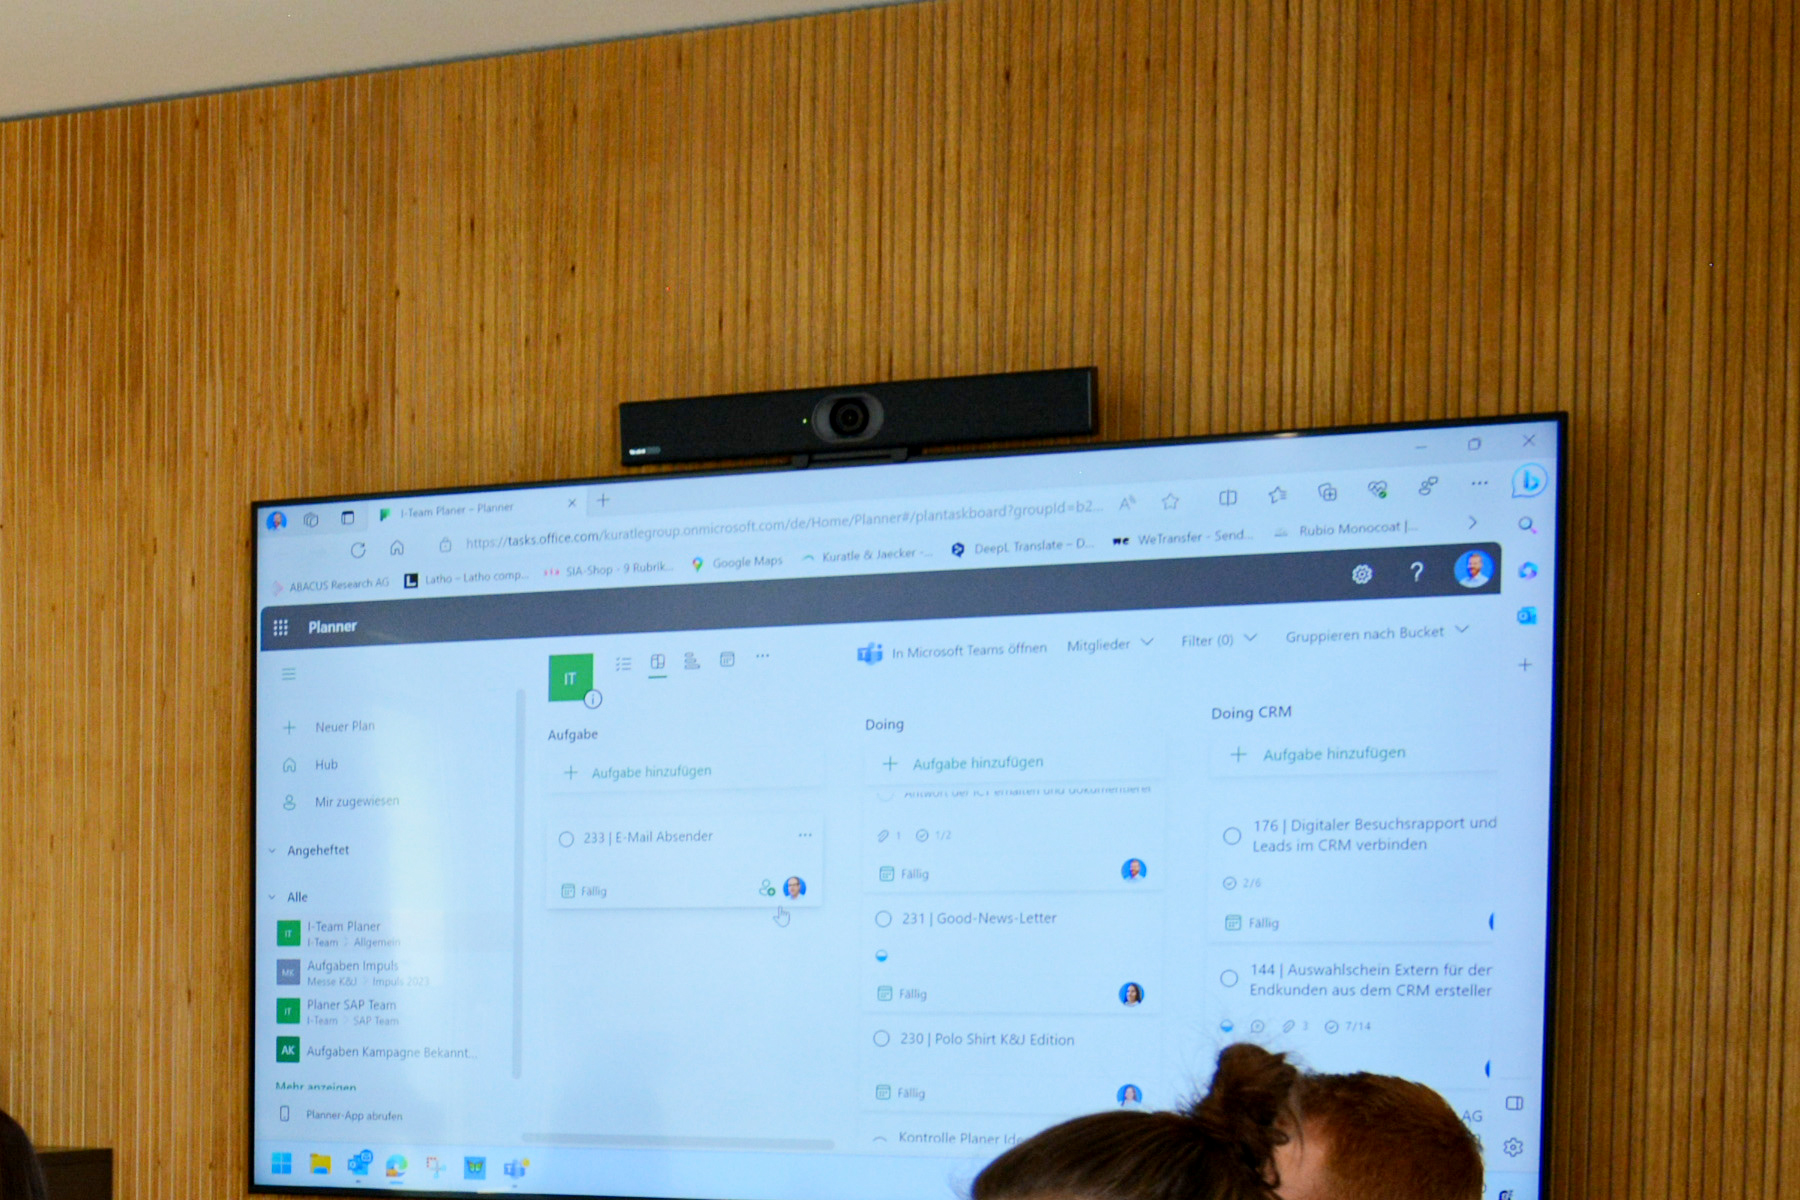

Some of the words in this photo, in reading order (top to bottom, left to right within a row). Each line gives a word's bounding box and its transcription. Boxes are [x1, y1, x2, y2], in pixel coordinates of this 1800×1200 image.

[436, 505, 466, 517] Planer
[477, 502, 514, 514] Planner
[1299, 524, 1334, 537] Rubio
[1338, 521, 1400, 535] Monocoat
[1138, 531, 1202, 546] WeTransfer
[975, 542, 1009, 556] DeepL
[1014, 539, 1063, 552] Translate
[713, 556, 751, 570] Google
[754, 555, 783, 568] Maps
[823, 550, 860, 563] Kuratle
[864, 550, 873, 560] &
[876, 548, 915, 560] Jaecker
[566, 564, 613, 577] SIA-Shop
[623, 563, 630, 573] 9
[290, 580, 329, 592] ABACUS
[331, 578, 373, 590] Research
[374, 576, 390, 587] AG
[425, 573, 452, 585] Latho
[463, 571, 491, 583] Latho
[308, 620, 358, 635] Planner
[1182, 634, 1213, 647] Filter
[1217, 633, 1234, 648] (0)
[1286, 630, 1359, 645] Gruppieren
[1363, 627, 1395, 641] nach
[1399, 625, 1444, 639] Bucket
[892, 647, 903, 659] In
[907, 645, 963, 659] Microsoft
[967, 643, 1004, 656] Teams
[1008, 641, 1047, 655] öffnen
[1067, 637, 1130, 654] Mitglieder
[564, 672, 577, 686] IT
[1211, 707, 1254, 721] Doing
[1258, 706, 1293, 719] CRM
[315, 720, 348, 733] Neuer
[352, 720, 375, 732] Plan
[865, 719, 905, 733] Doing
[547, 728, 599, 744] Aufgabe
[1263, 748, 1323, 764] Aufgabe
[1326, 746, 1406, 762] hinzufügen
[315, 759, 338, 770] Hub
[913, 757, 967, 773] Aufgabe
[971, 755, 1044, 771] hinzufügen
[591, 767, 641, 781] Aufgabe
[645, 764, 712, 780] hinzufügen
[315, 796, 333, 808] Mir
[336, 794, 400, 810] zugewiesen
[1254, 820, 1278, 833] 176
[1291, 818, 1350, 834] Digitaler
[1354, 817, 1465, 833] Besuchsrapport
[1470, 816, 1497, 830] und
[583, 832, 605, 844] 233
[615, 830, 653, 844] E-Mail
[656, 830, 714, 843] Absender
[1253, 839, 1292, 853] Leads
[1296, 838, 1314, 852] im
[1318, 838, 1351, 852] CRM
[1356, 837, 1428, 852] verbinden
[287, 844, 349, 862] Angeheftet
[901, 868, 929, 882] Fällig
[287, 891, 308, 903] Alle
[581, 886, 607, 898] Fällig
[902, 913, 925, 925] 231
[936, 912, 1057, 925] Good-News-Letter
[1249, 917, 1279, 932] Fällig
[307, 921, 344, 932] I-Team
[347, 921, 381, 932] Planer
[307, 937, 339, 947] I-Team
[354, 937, 401, 949] Allgemein
[307, 960, 360, 973] Aufgaben
[363, 960, 399, 973] Impuls
[1251, 963, 1275, 976] 144
[1287, 963, 1390, 977] Auswahlschein
[1394, 963, 1439, 977] Extern
[1443, 962, 1464, 977] für
[307, 977, 336, 986] Messe
[372, 976, 404, 988] Impuls
[406, 976, 430, 987] 2023
[899, 988, 927, 1002] Fällig
[1250, 983, 1327, 997] Endkunden
[1331, 986, 1356, 997] aus
[1360, 983, 1391, 997] dem
[1396, 984, 1430, 997] CRM
[307, 999, 340, 1011] Planer
[343, 999, 365, 1011] SAP
[369, 1000, 397, 1011] Team
[353, 1016, 372, 1026] SAP
[375, 1016, 399, 1026] Team
[1345, 1021, 1371, 1031] 7/14
[900, 1033, 924, 1045] 230
[935, 1033, 963, 1045] Polo
[966, 1032, 996, 1045] Shirt
[1000, 1033, 1026, 1046] K&J
[1030, 1033, 1075, 1047] Edition
[281, 1045, 295, 1056] AK
[307, 1046, 359, 1059] Aufgaben
[362, 1046, 421, 1060] Kampagne
[897, 1088, 926, 1101] Fällig
[306, 1109, 364, 1121] Planner-App
[366, 1111, 403, 1121] abrufen
[898, 1131, 956, 1144] Kontrolle
[960, 1132, 999, 1145] Planer
